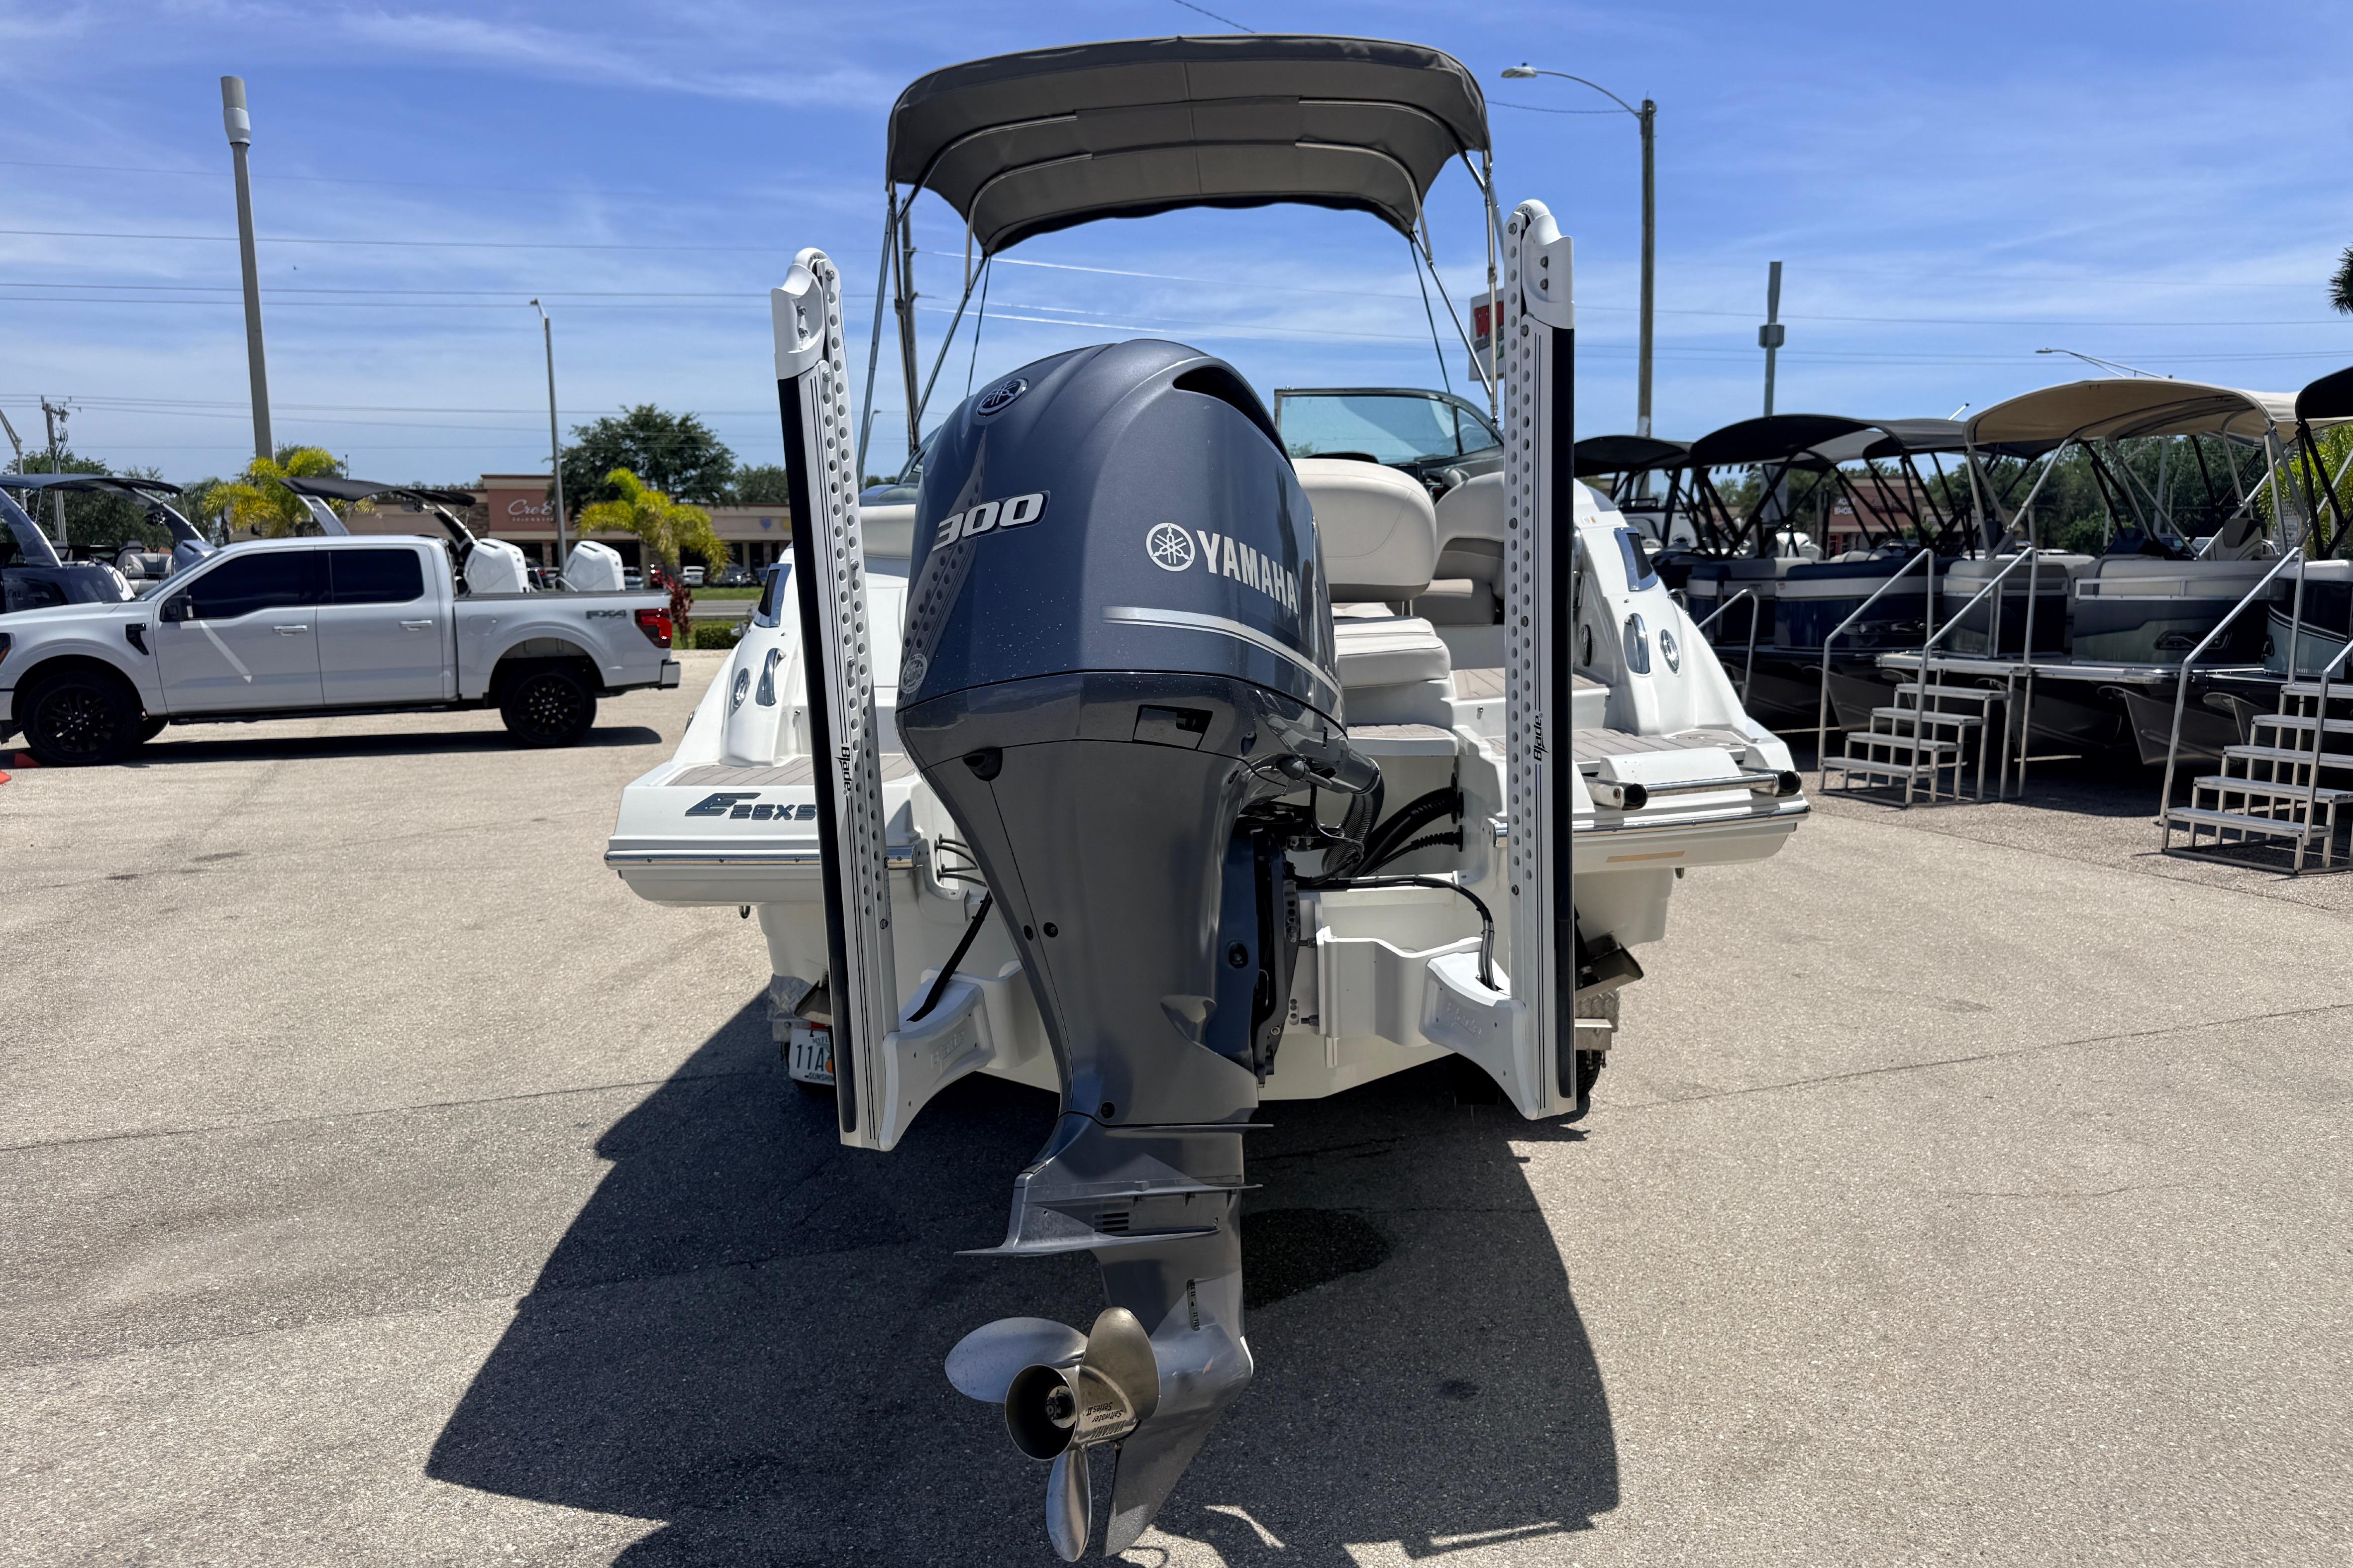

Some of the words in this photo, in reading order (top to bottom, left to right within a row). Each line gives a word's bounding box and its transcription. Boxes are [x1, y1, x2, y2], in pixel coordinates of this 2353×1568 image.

[932, 493, 1043, 551] 300
[1196, 530, 1298, 614] YAMAHA
[797, 1044, 824, 1072] 11A
[1092, 1409, 1124, 1423] Saltwater
[1093, 1402, 1113, 1413] Series
[1090, 1420, 1126, 1439] YAMAHA
